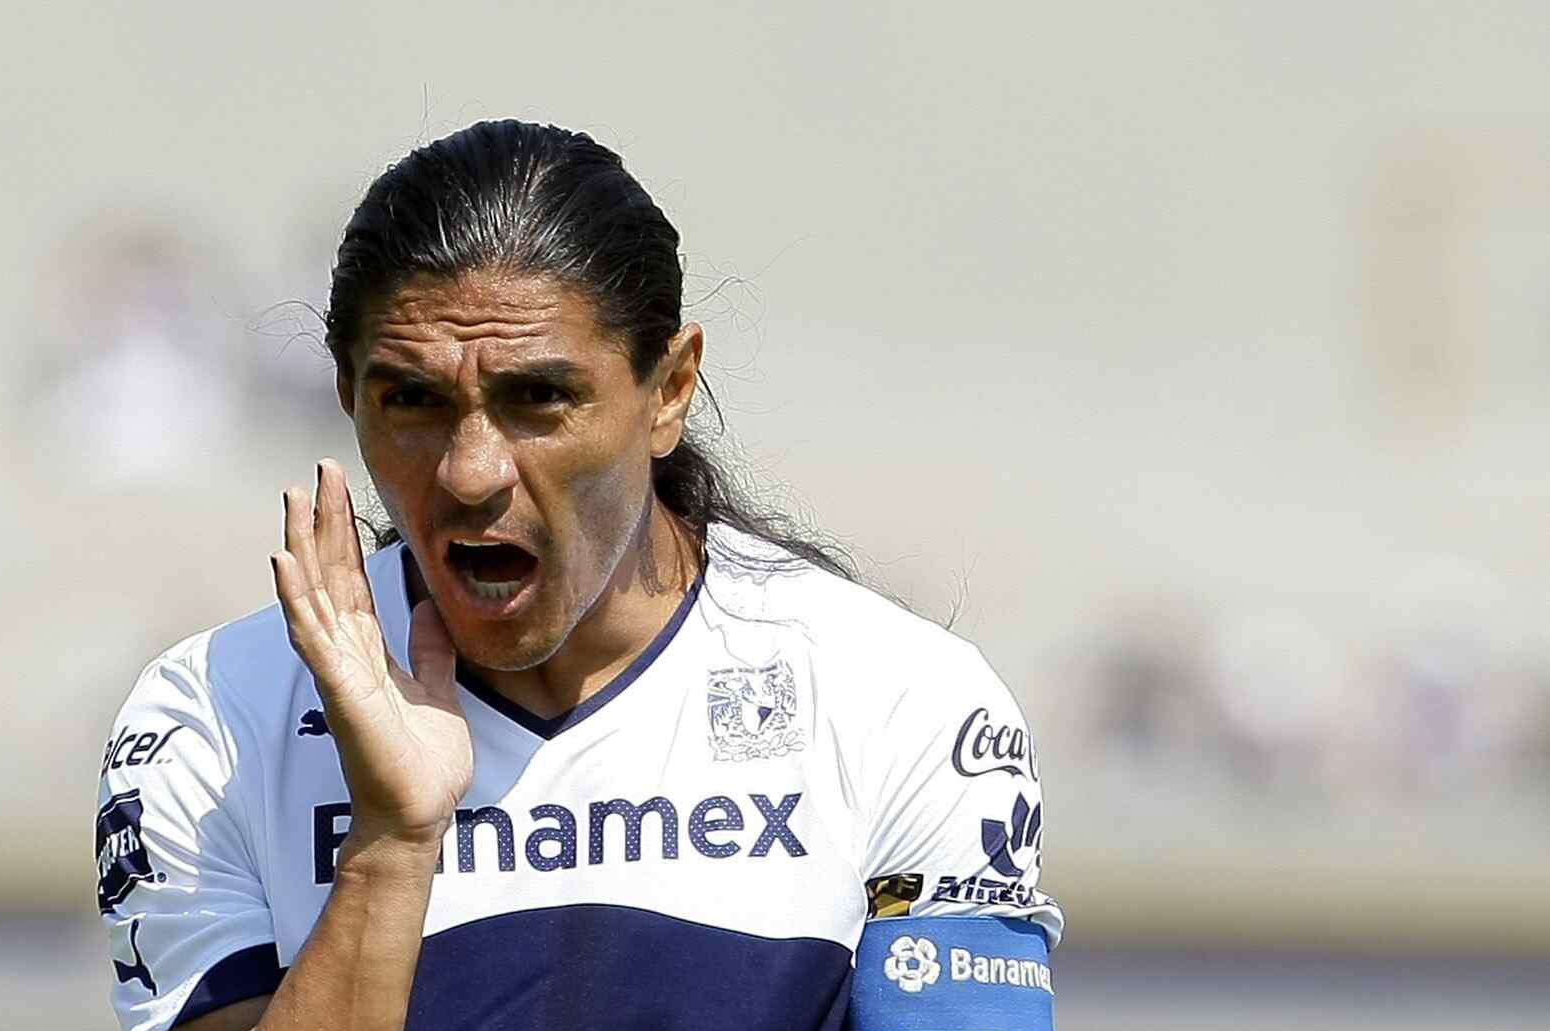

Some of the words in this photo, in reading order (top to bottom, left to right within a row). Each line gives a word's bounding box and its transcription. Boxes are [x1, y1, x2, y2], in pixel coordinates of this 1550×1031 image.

[100, 724, 187, 778] elcel
[313, 792, 810, 885] Bnamex
[950, 947, 1055, 997] Baname
